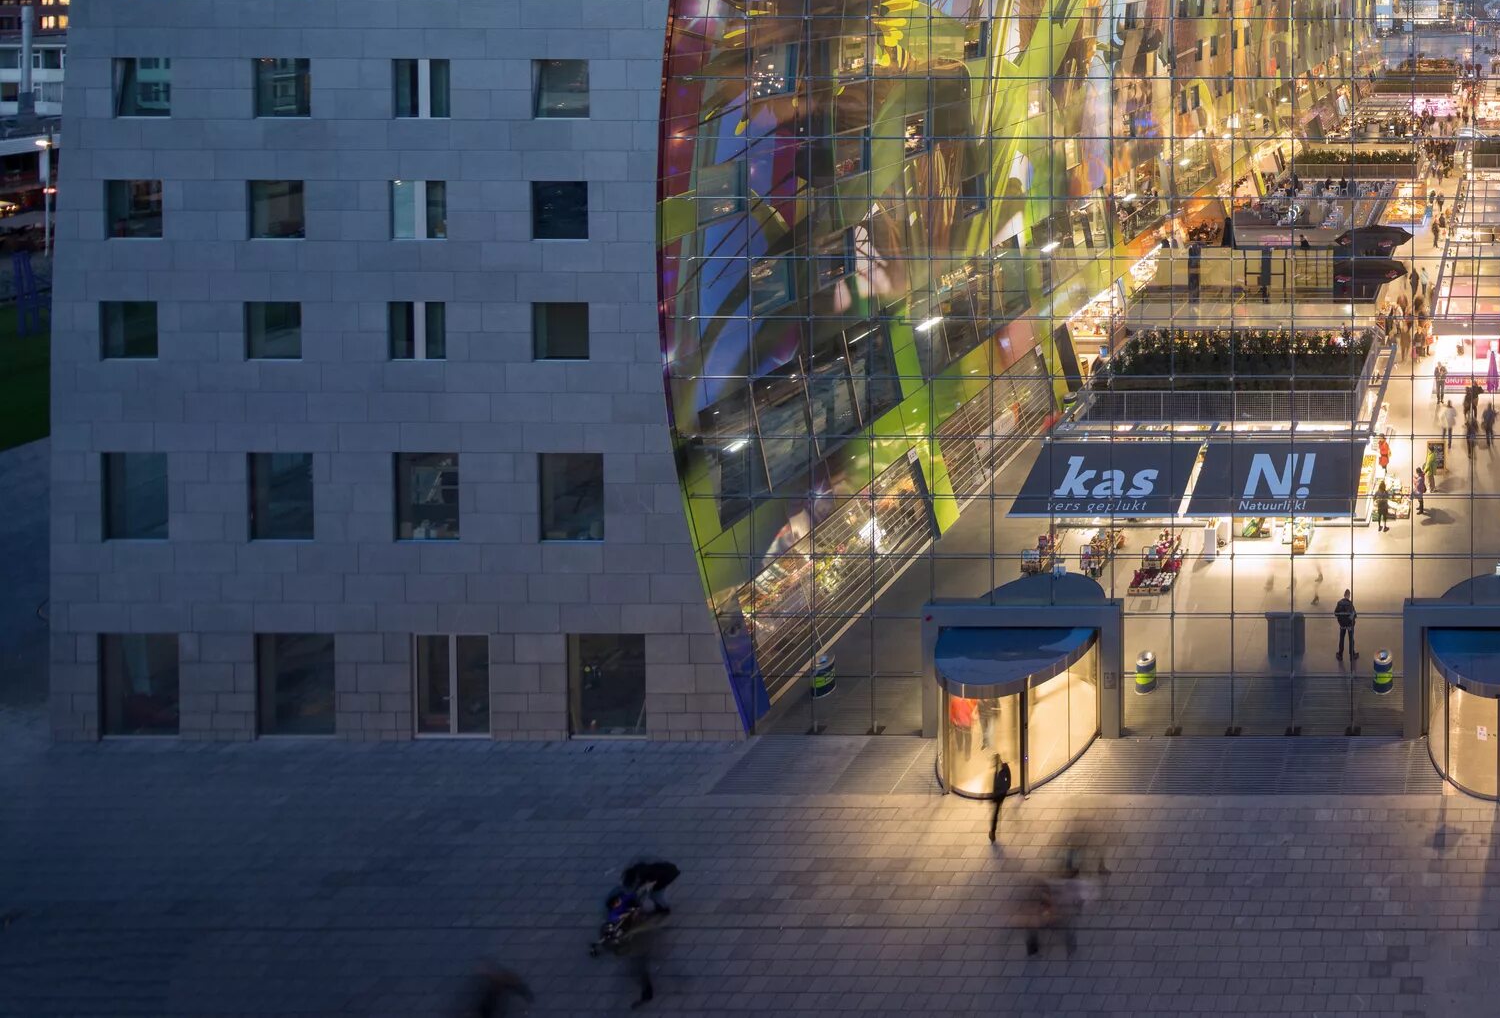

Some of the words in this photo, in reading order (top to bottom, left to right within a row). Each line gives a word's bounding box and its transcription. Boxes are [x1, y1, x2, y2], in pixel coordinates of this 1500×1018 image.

[1053, 455, 1159, 499] kas
[1242, 453, 1317, 499] N!
[1047, 502, 1079, 511] vers
[1087, 500, 1148, 513] geplukt
